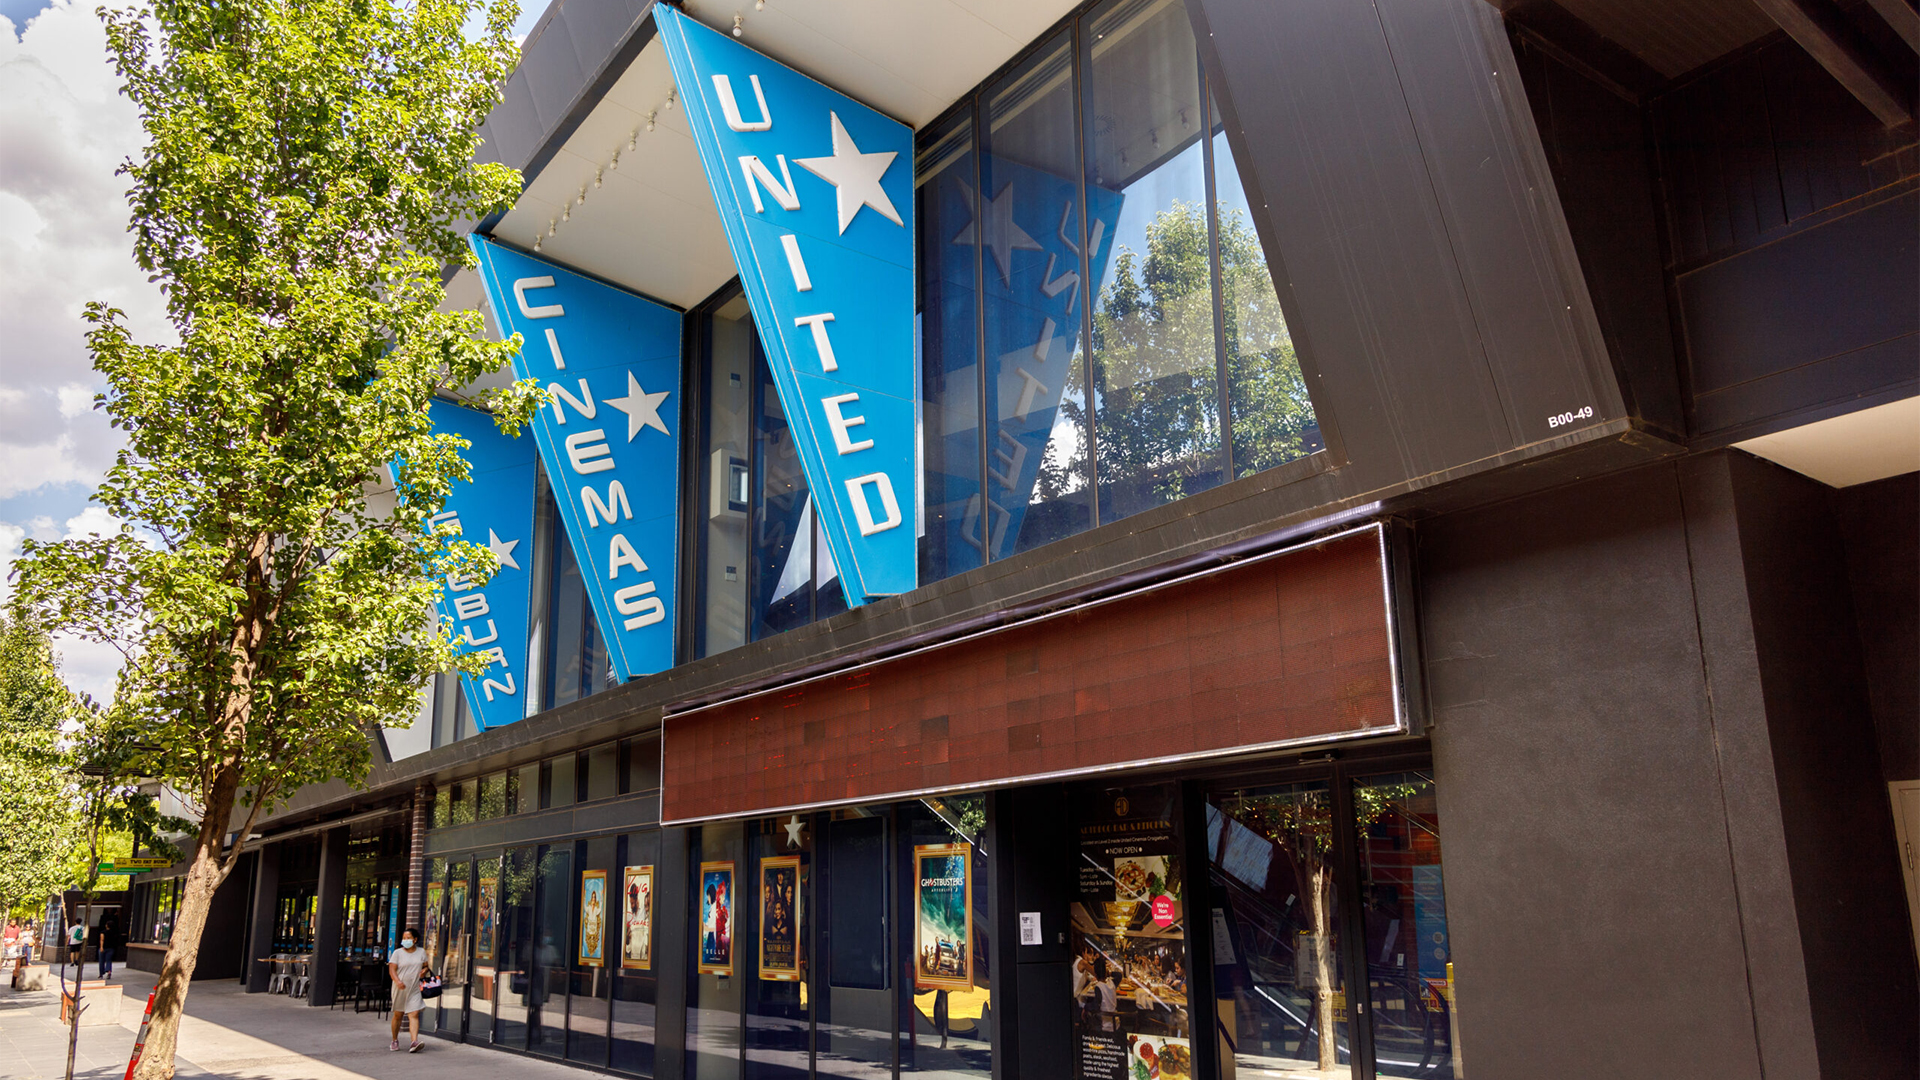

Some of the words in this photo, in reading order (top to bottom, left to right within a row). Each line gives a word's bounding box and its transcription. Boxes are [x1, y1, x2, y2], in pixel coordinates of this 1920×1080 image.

[712, 73, 902, 537] UNITED
[1548, 406, 1594, 428] B00-49
[513, 275, 666, 631] CINEMAS
[1123, 846, 1138, 854] OPEN
[921, 877, 964, 887] GHOSTBUSTERS
[705, 948, 725, 956] BELLE
